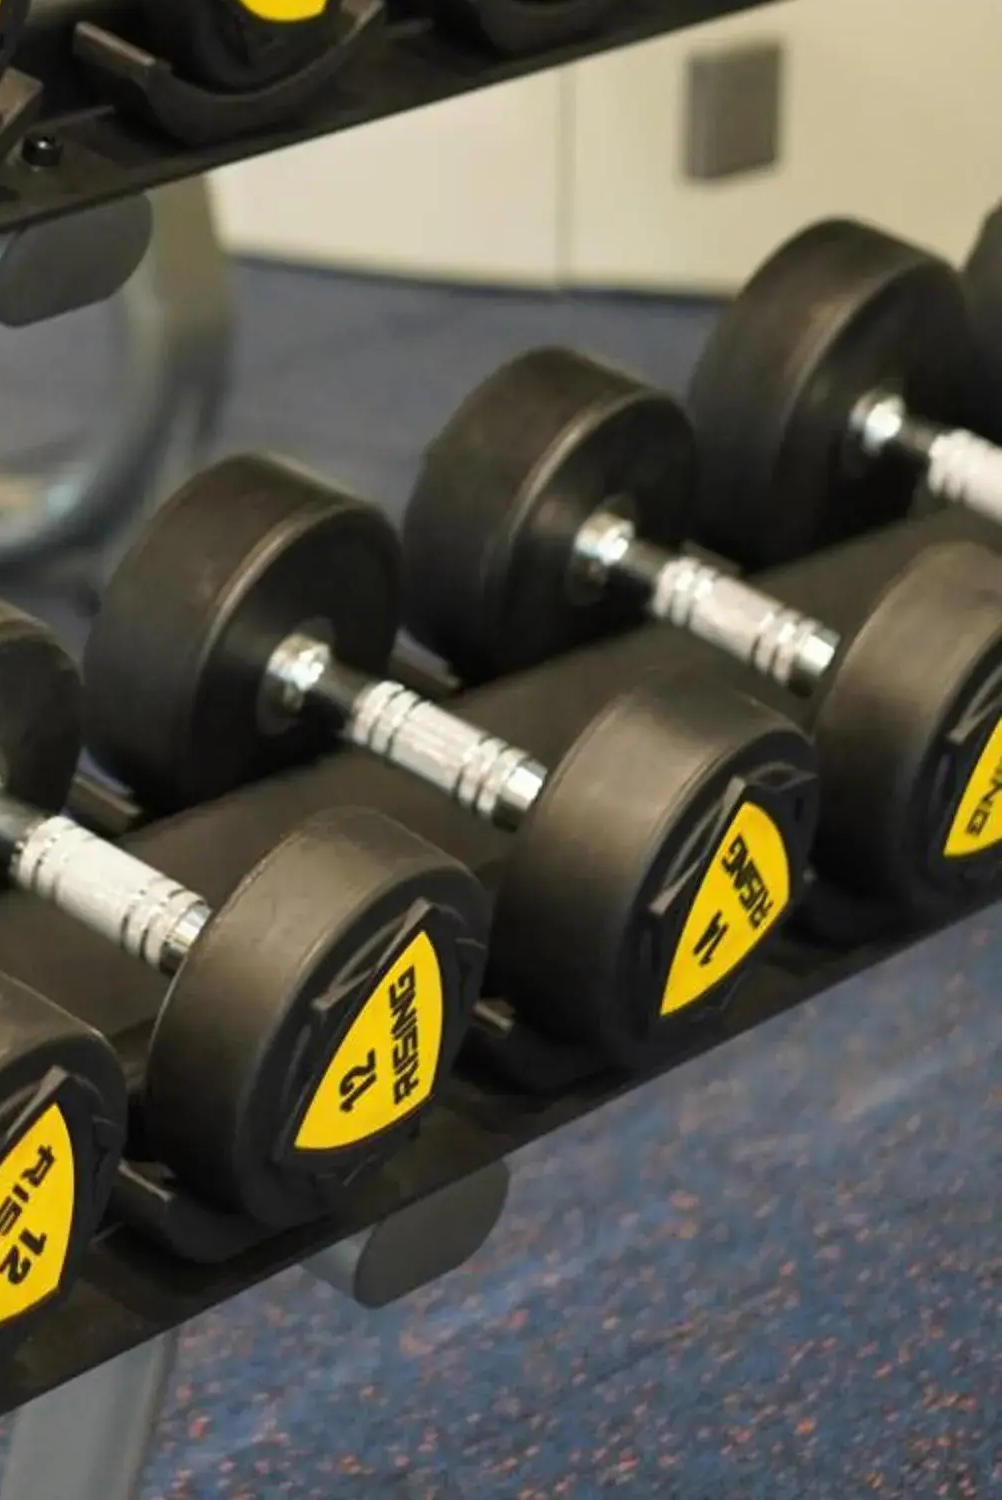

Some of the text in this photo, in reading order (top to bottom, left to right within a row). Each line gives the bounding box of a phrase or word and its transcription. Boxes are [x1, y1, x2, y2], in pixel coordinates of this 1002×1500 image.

[721, 832, 774, 931] RISING
[339, 1048, 377, 1114] 12
[389, 965, 420, 1106] RISING
